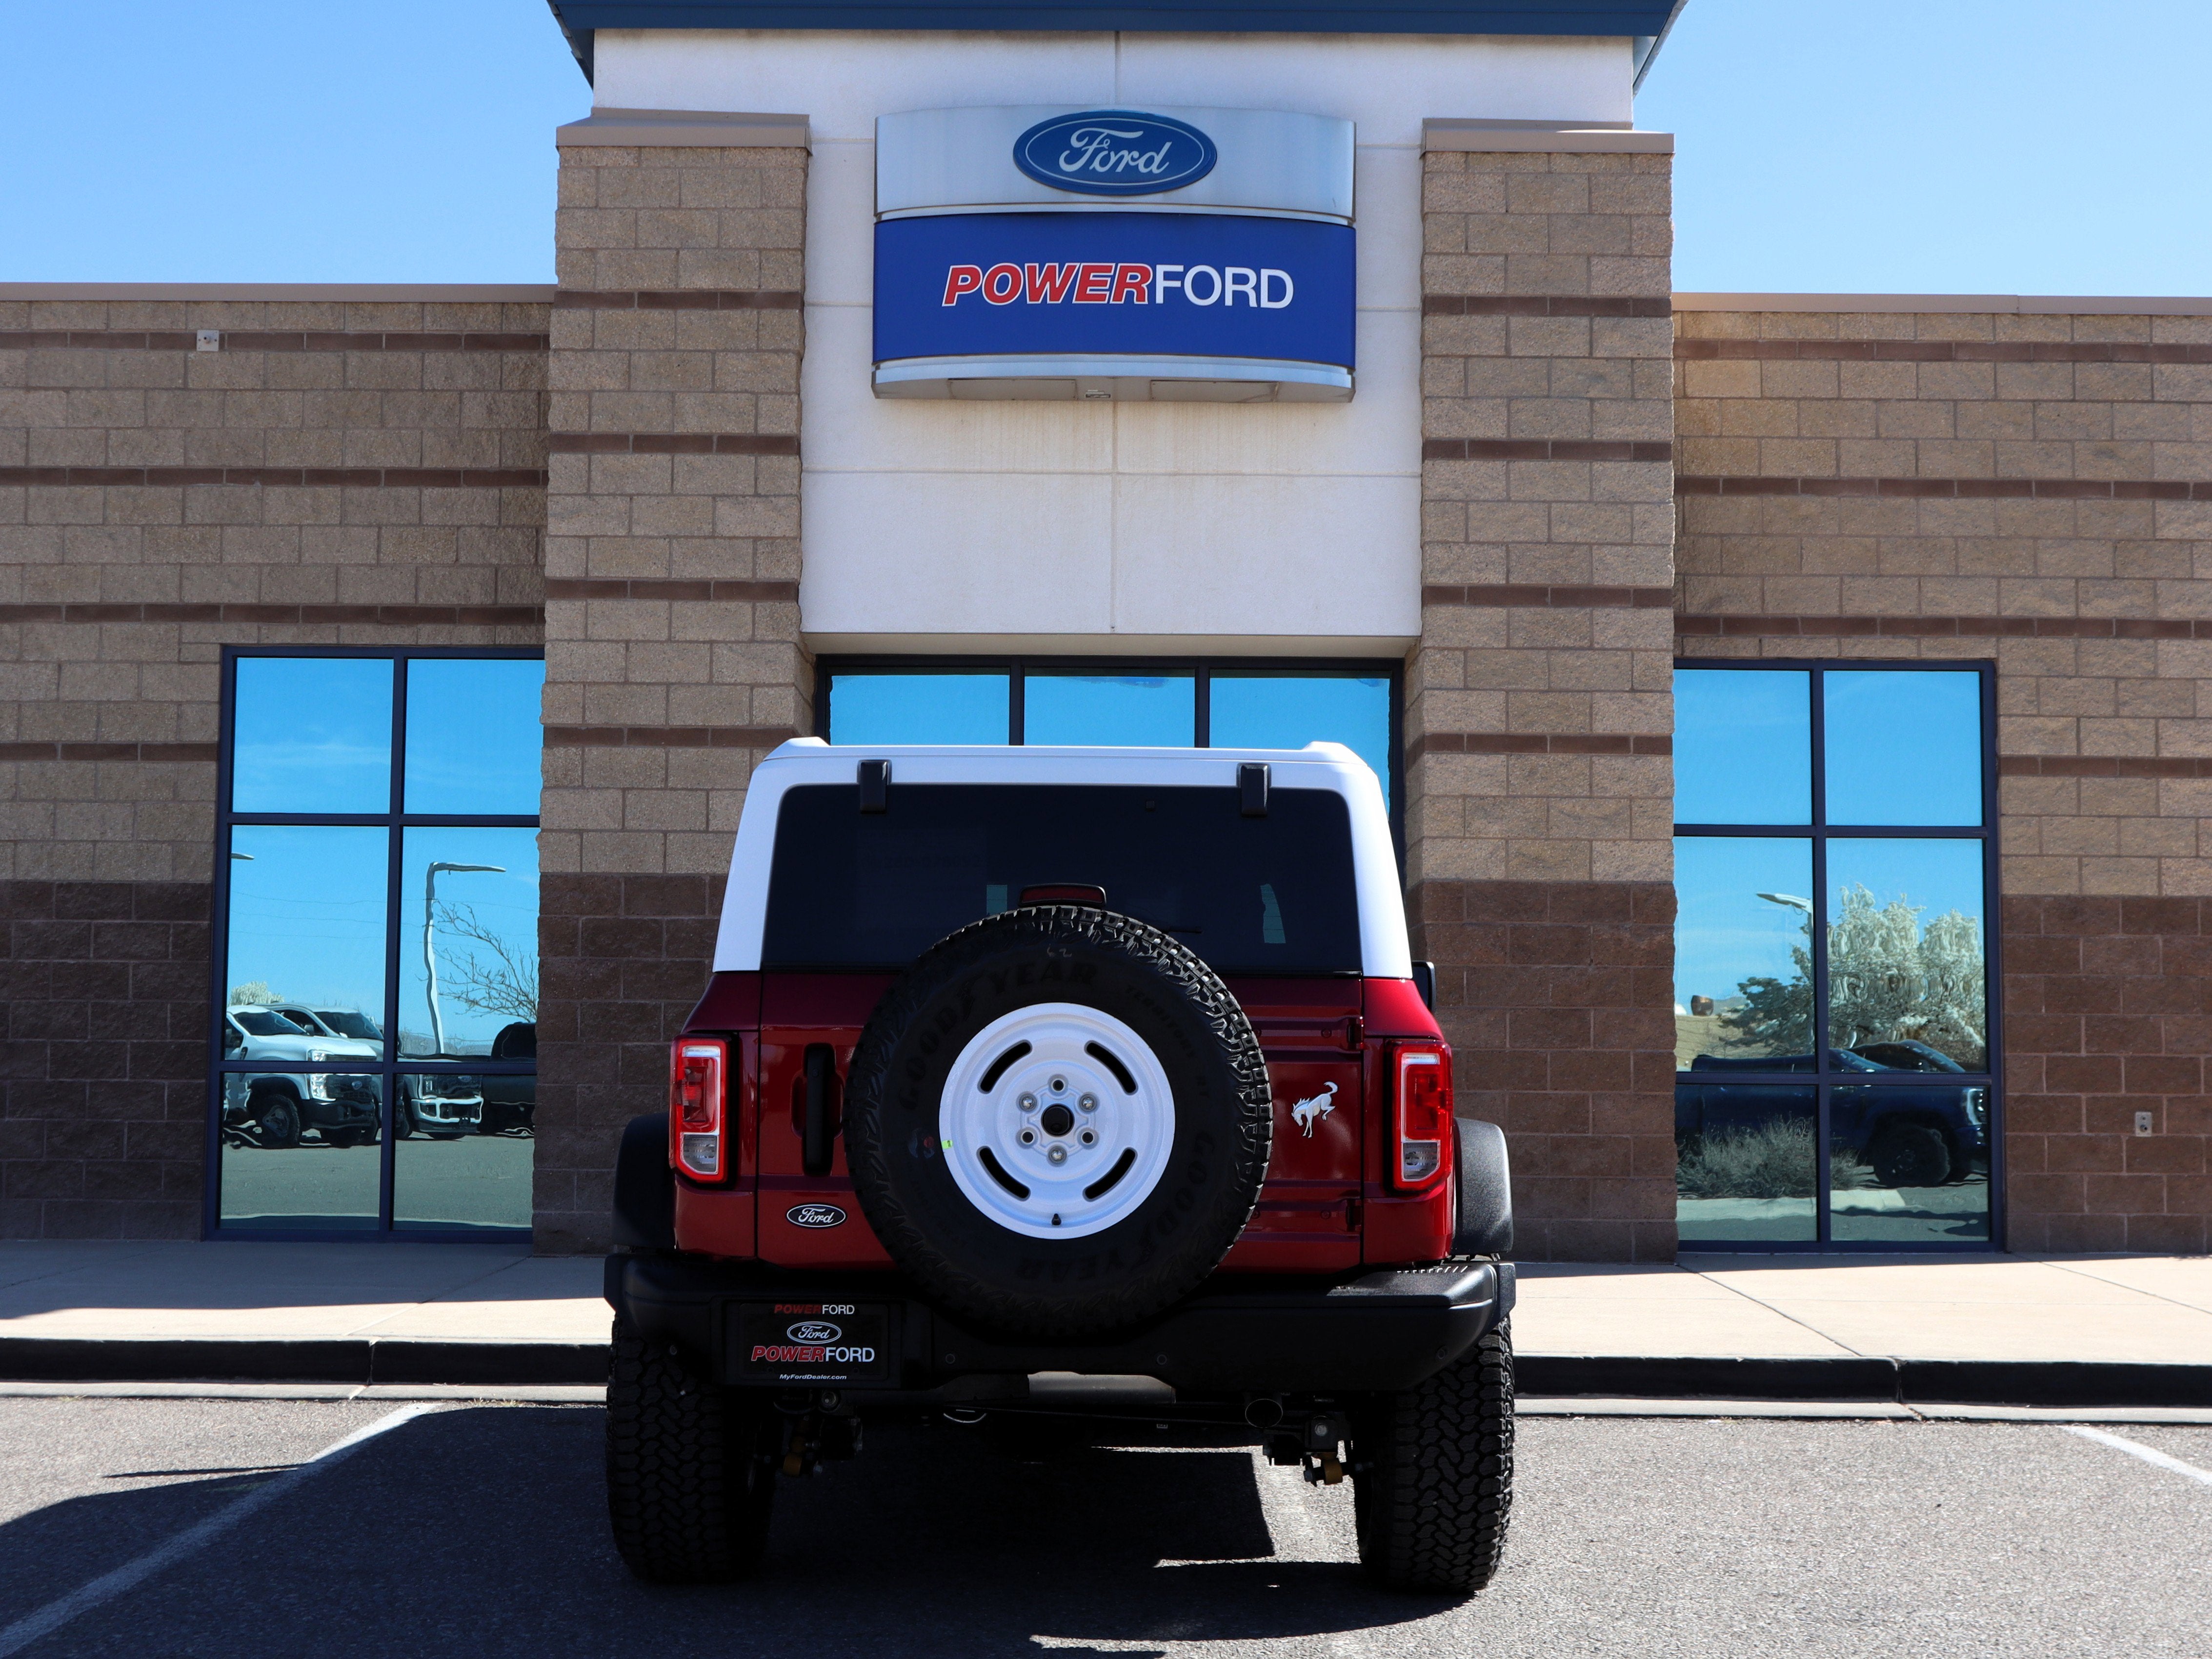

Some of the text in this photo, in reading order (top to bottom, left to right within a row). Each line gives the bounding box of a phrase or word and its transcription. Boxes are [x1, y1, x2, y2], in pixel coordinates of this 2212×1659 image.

[1059, 127, 1172, 174] Ford
[942, 262, 1294, 309] POWERFORD
[896, 959, 1101, 1111] GOODYEAR
[1123, 983, 1198, 1061] TERRITORY
[798, 1208, 835, 1223] Ford
[1013, 1129, 1218, 1282] GOODYEAR
[774, 1304, 855, 1315] POWERFORD
[798, 1325, 831, 1339] Ford
[751, 1345, 875, 1362] POWERFORD
